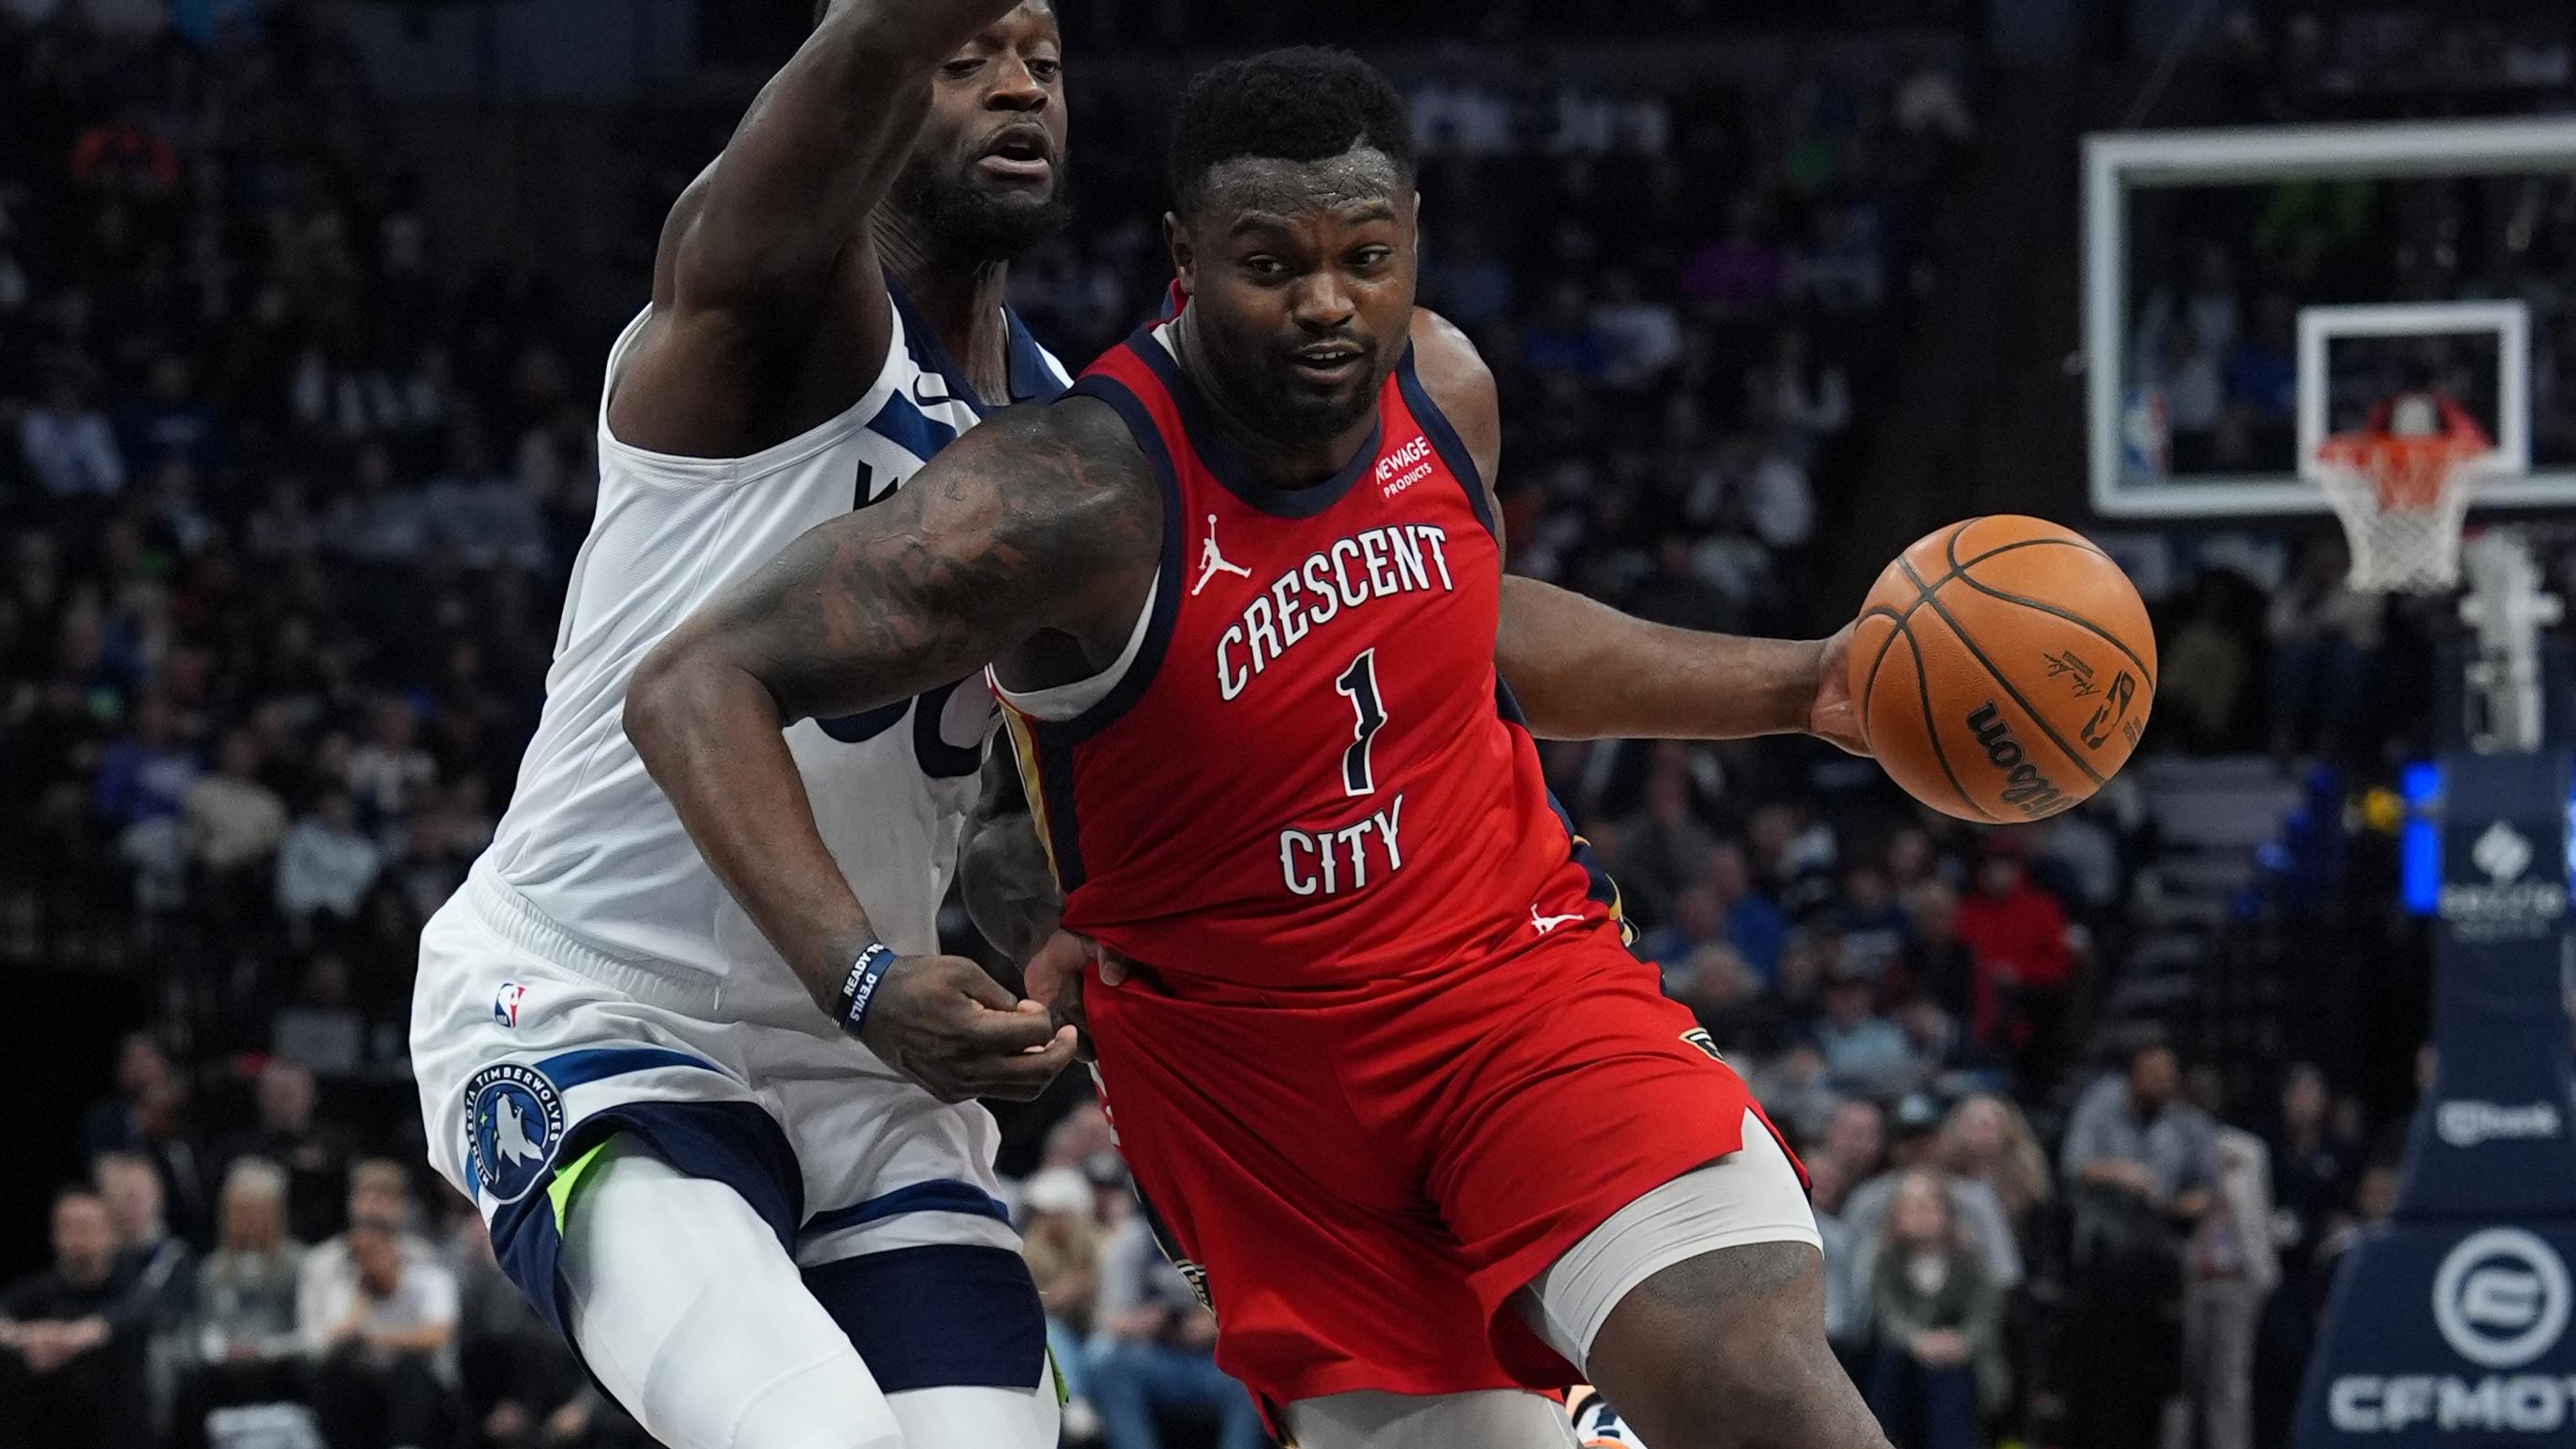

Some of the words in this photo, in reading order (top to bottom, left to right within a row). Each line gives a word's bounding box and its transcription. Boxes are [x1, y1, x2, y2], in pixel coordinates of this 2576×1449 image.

[1375, 435, 1431, 485] NEWAGE
[1383, 462, 1432, 499] PRODUCTS
[1216, 524, 1454, 702] CRESCENT
[1335, 646, 1389, 797] 1
[1279, 792, 1404, 896] CITY
[843, 952, 871, 997] READY
[867, 943, 885, 954] TO
[475, 1067, 561, 1142] TIMBERWOLVES
